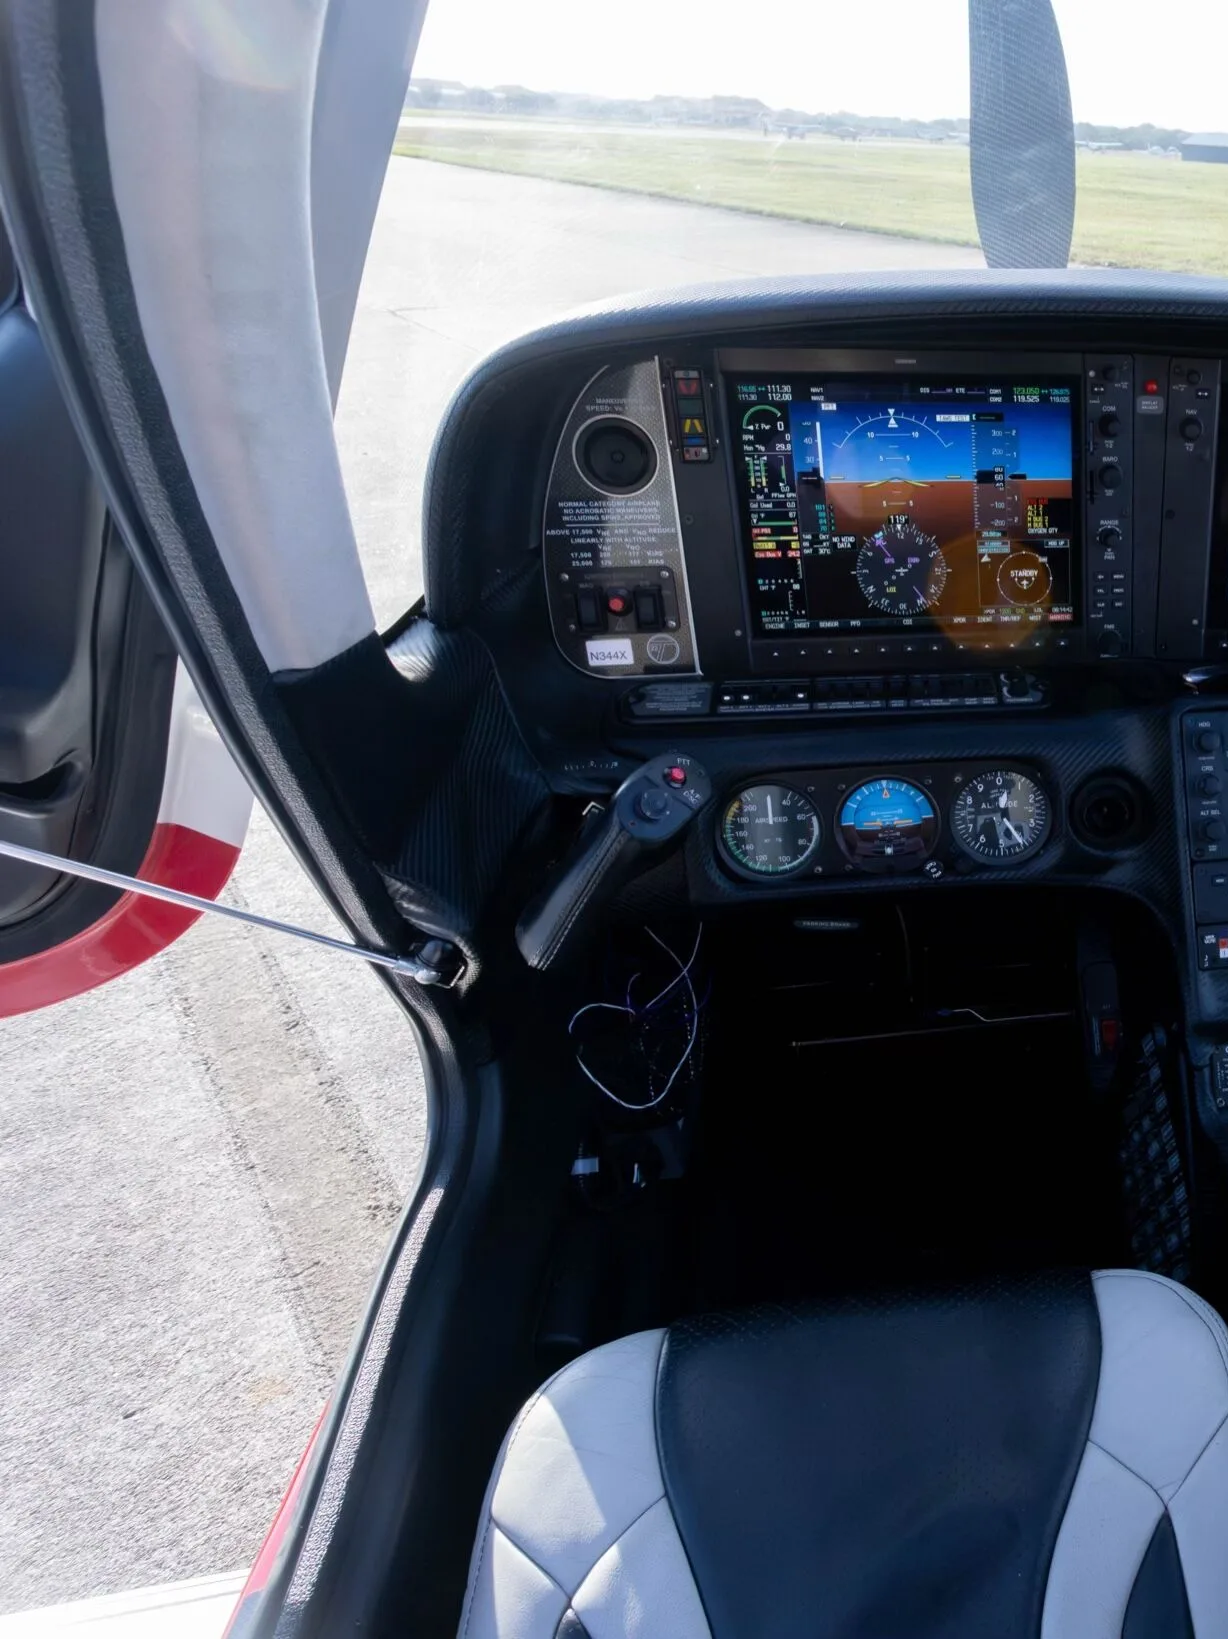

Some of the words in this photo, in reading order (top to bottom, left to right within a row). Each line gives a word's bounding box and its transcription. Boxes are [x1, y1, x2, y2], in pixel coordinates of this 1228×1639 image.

[590, 650, 627, 661] N344X
[996, 776, 1002, 785] 0
[977, 784, 983, 792] 9
[980, 834, 986, 843] 6
